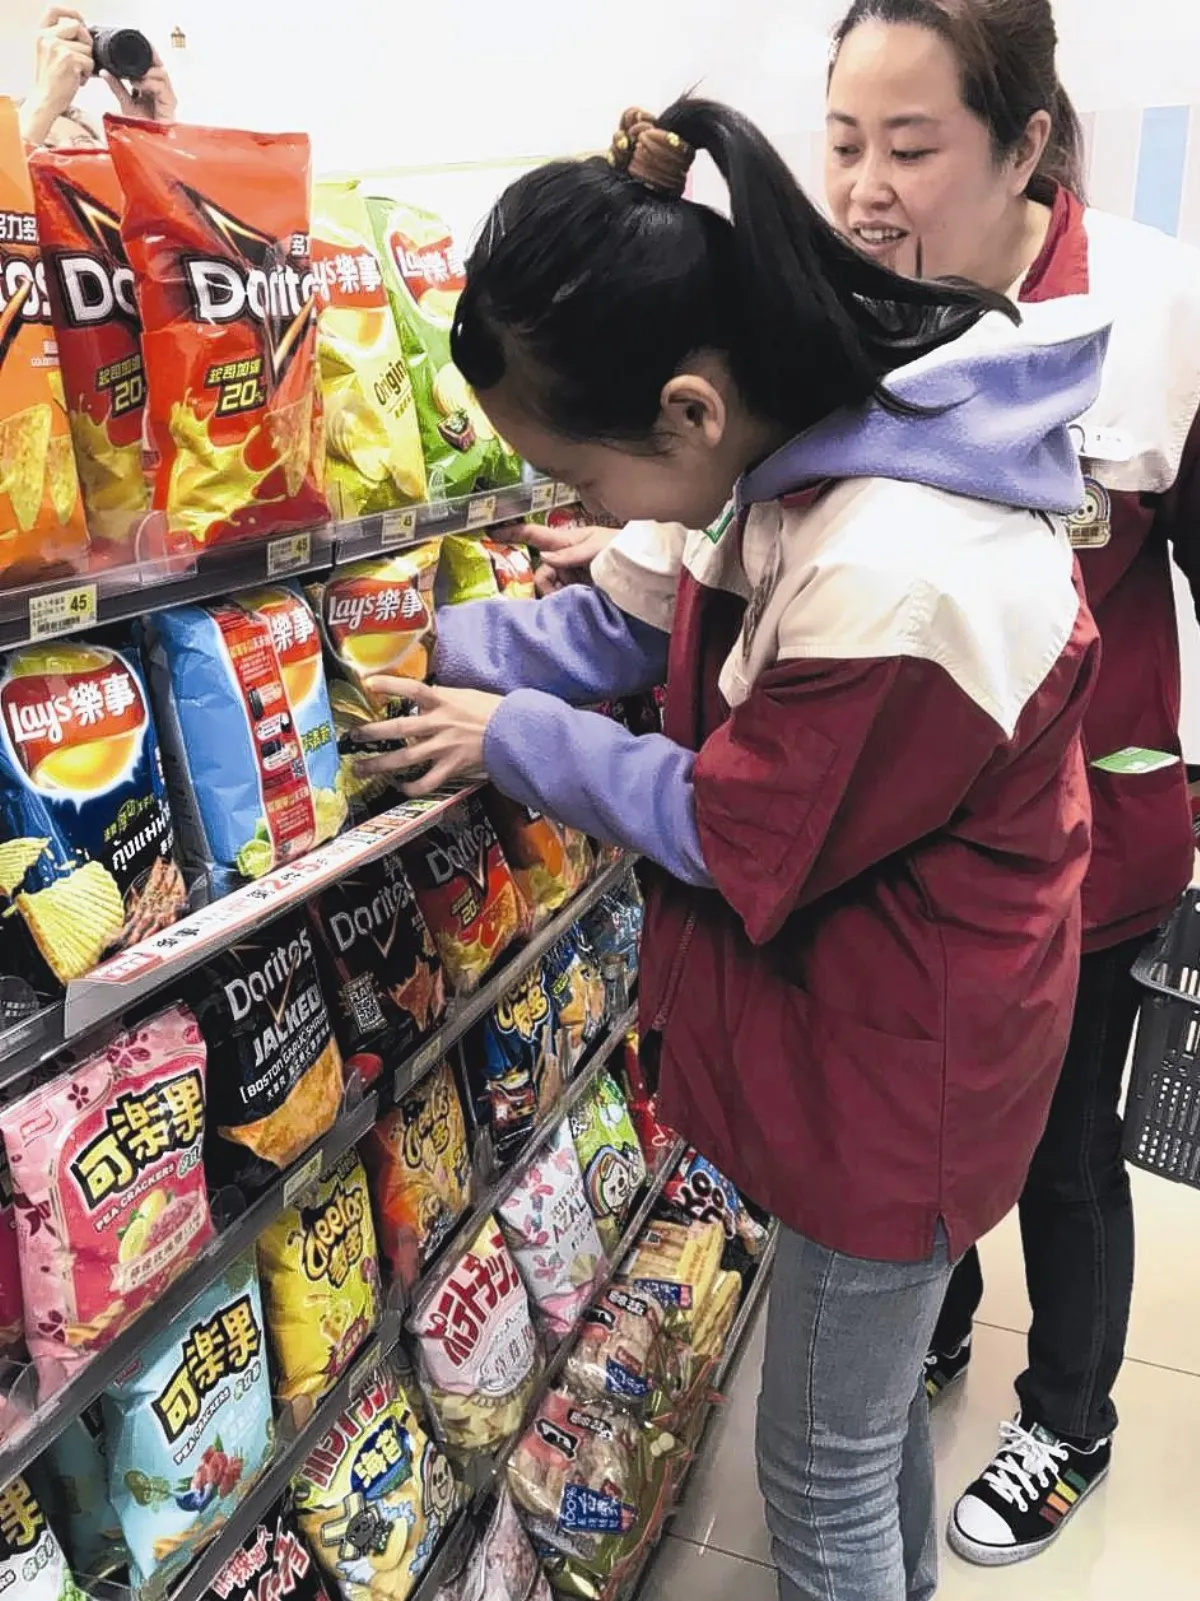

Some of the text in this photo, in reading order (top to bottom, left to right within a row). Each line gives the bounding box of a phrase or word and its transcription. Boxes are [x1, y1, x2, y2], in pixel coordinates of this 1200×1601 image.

[70, 594, 88, 612] 45
[328, 588, 423, 631] Lay's 樂事
[9, 672, 136, 744] Lay's 樂事
[329, 880, 413, 952] Doritos
[223, 926, 313, 1021] Doritos
[94, 1162, 176, 1232] PEA CRACKERS
